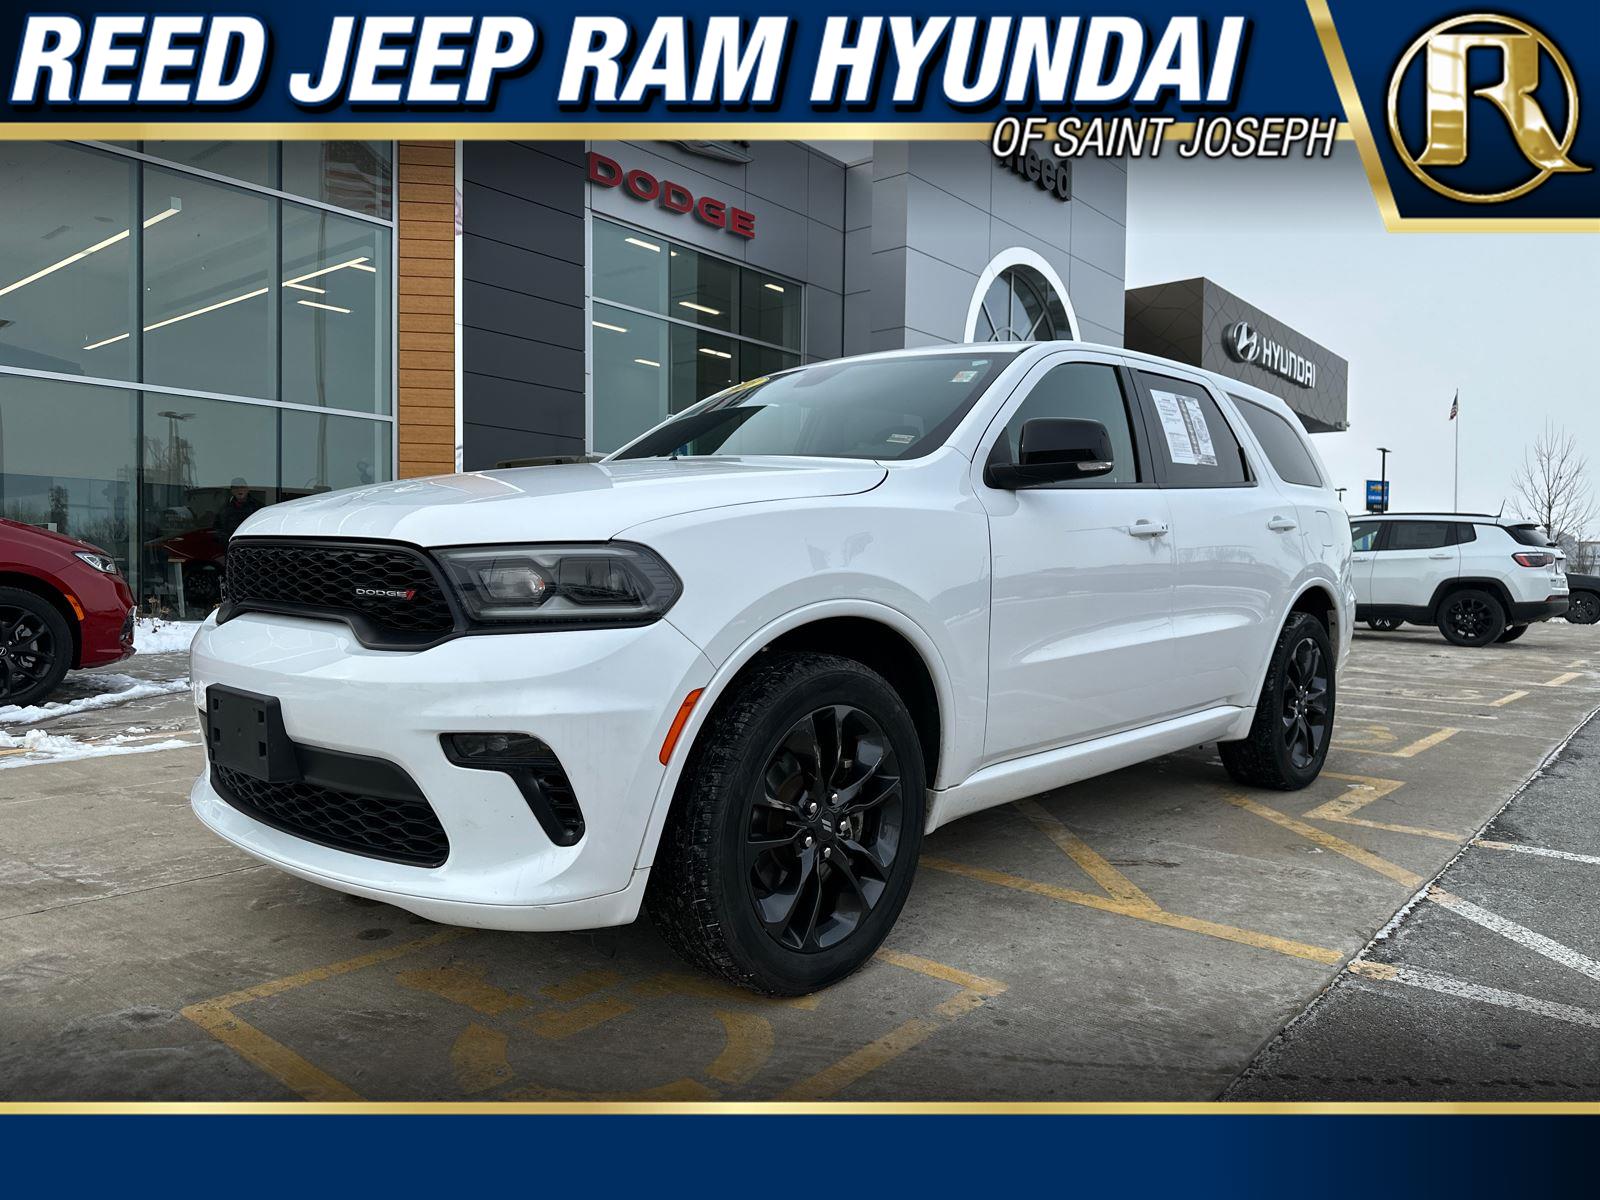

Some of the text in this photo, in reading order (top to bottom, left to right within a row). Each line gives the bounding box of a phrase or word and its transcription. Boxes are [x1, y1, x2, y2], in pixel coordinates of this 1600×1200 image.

[585, 151, 756, 240] DODGE
[1001, 147, 1072, 201] eed
[1262, 337, 1316, 389] HYUNDAI
[355, 588, 408, 599] DODGE
